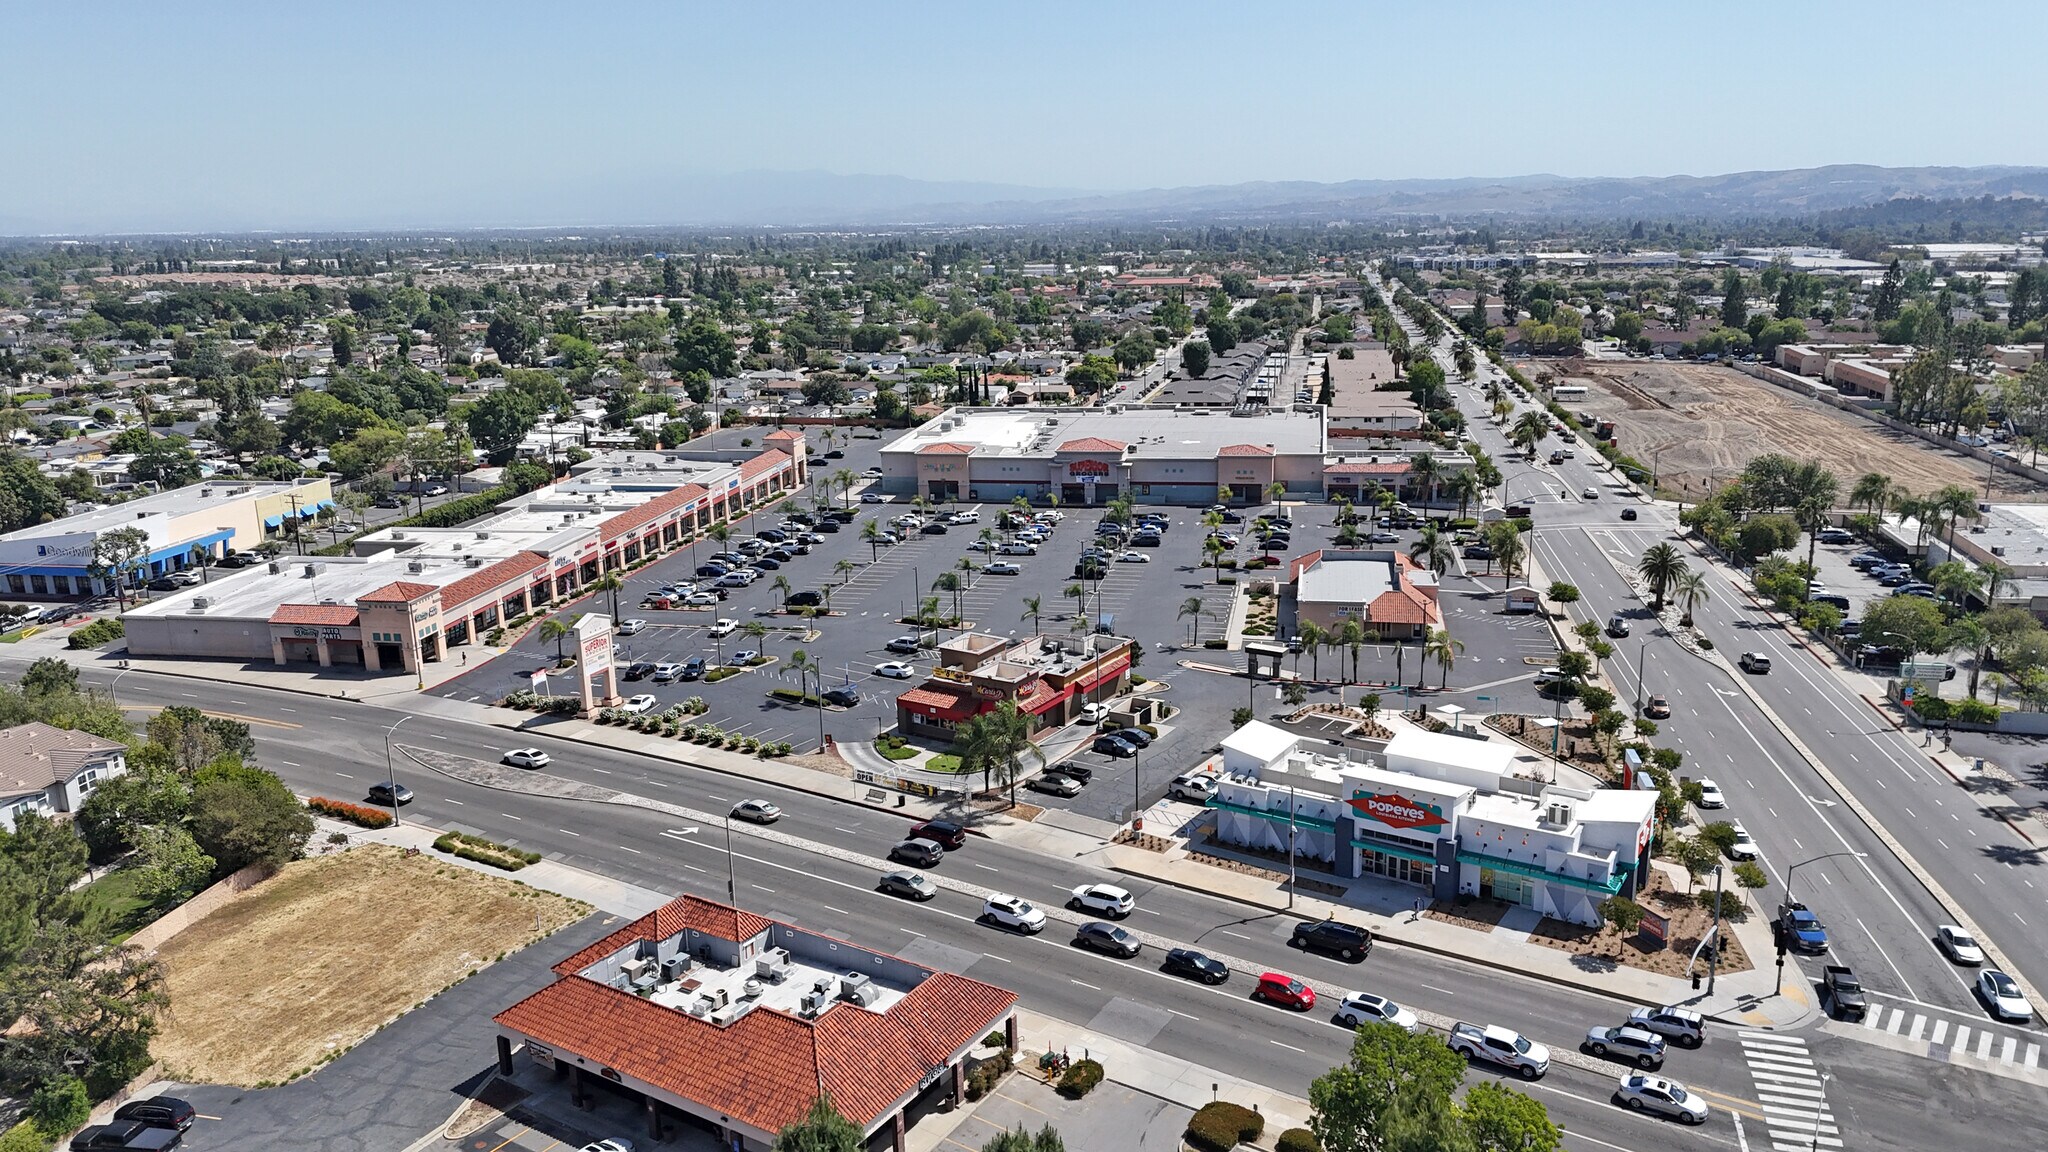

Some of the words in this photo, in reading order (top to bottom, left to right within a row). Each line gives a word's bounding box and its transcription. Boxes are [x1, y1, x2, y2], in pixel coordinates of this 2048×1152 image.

[47, 545, 93, 557] Goodwill
[585, 638, 608, 653] SUPERIOR
[856, 773, 874, 782] OPEN
[1368, 799, 1425, 820] POPEYES
[1397, 815, 1416, 823] KITCHEN
